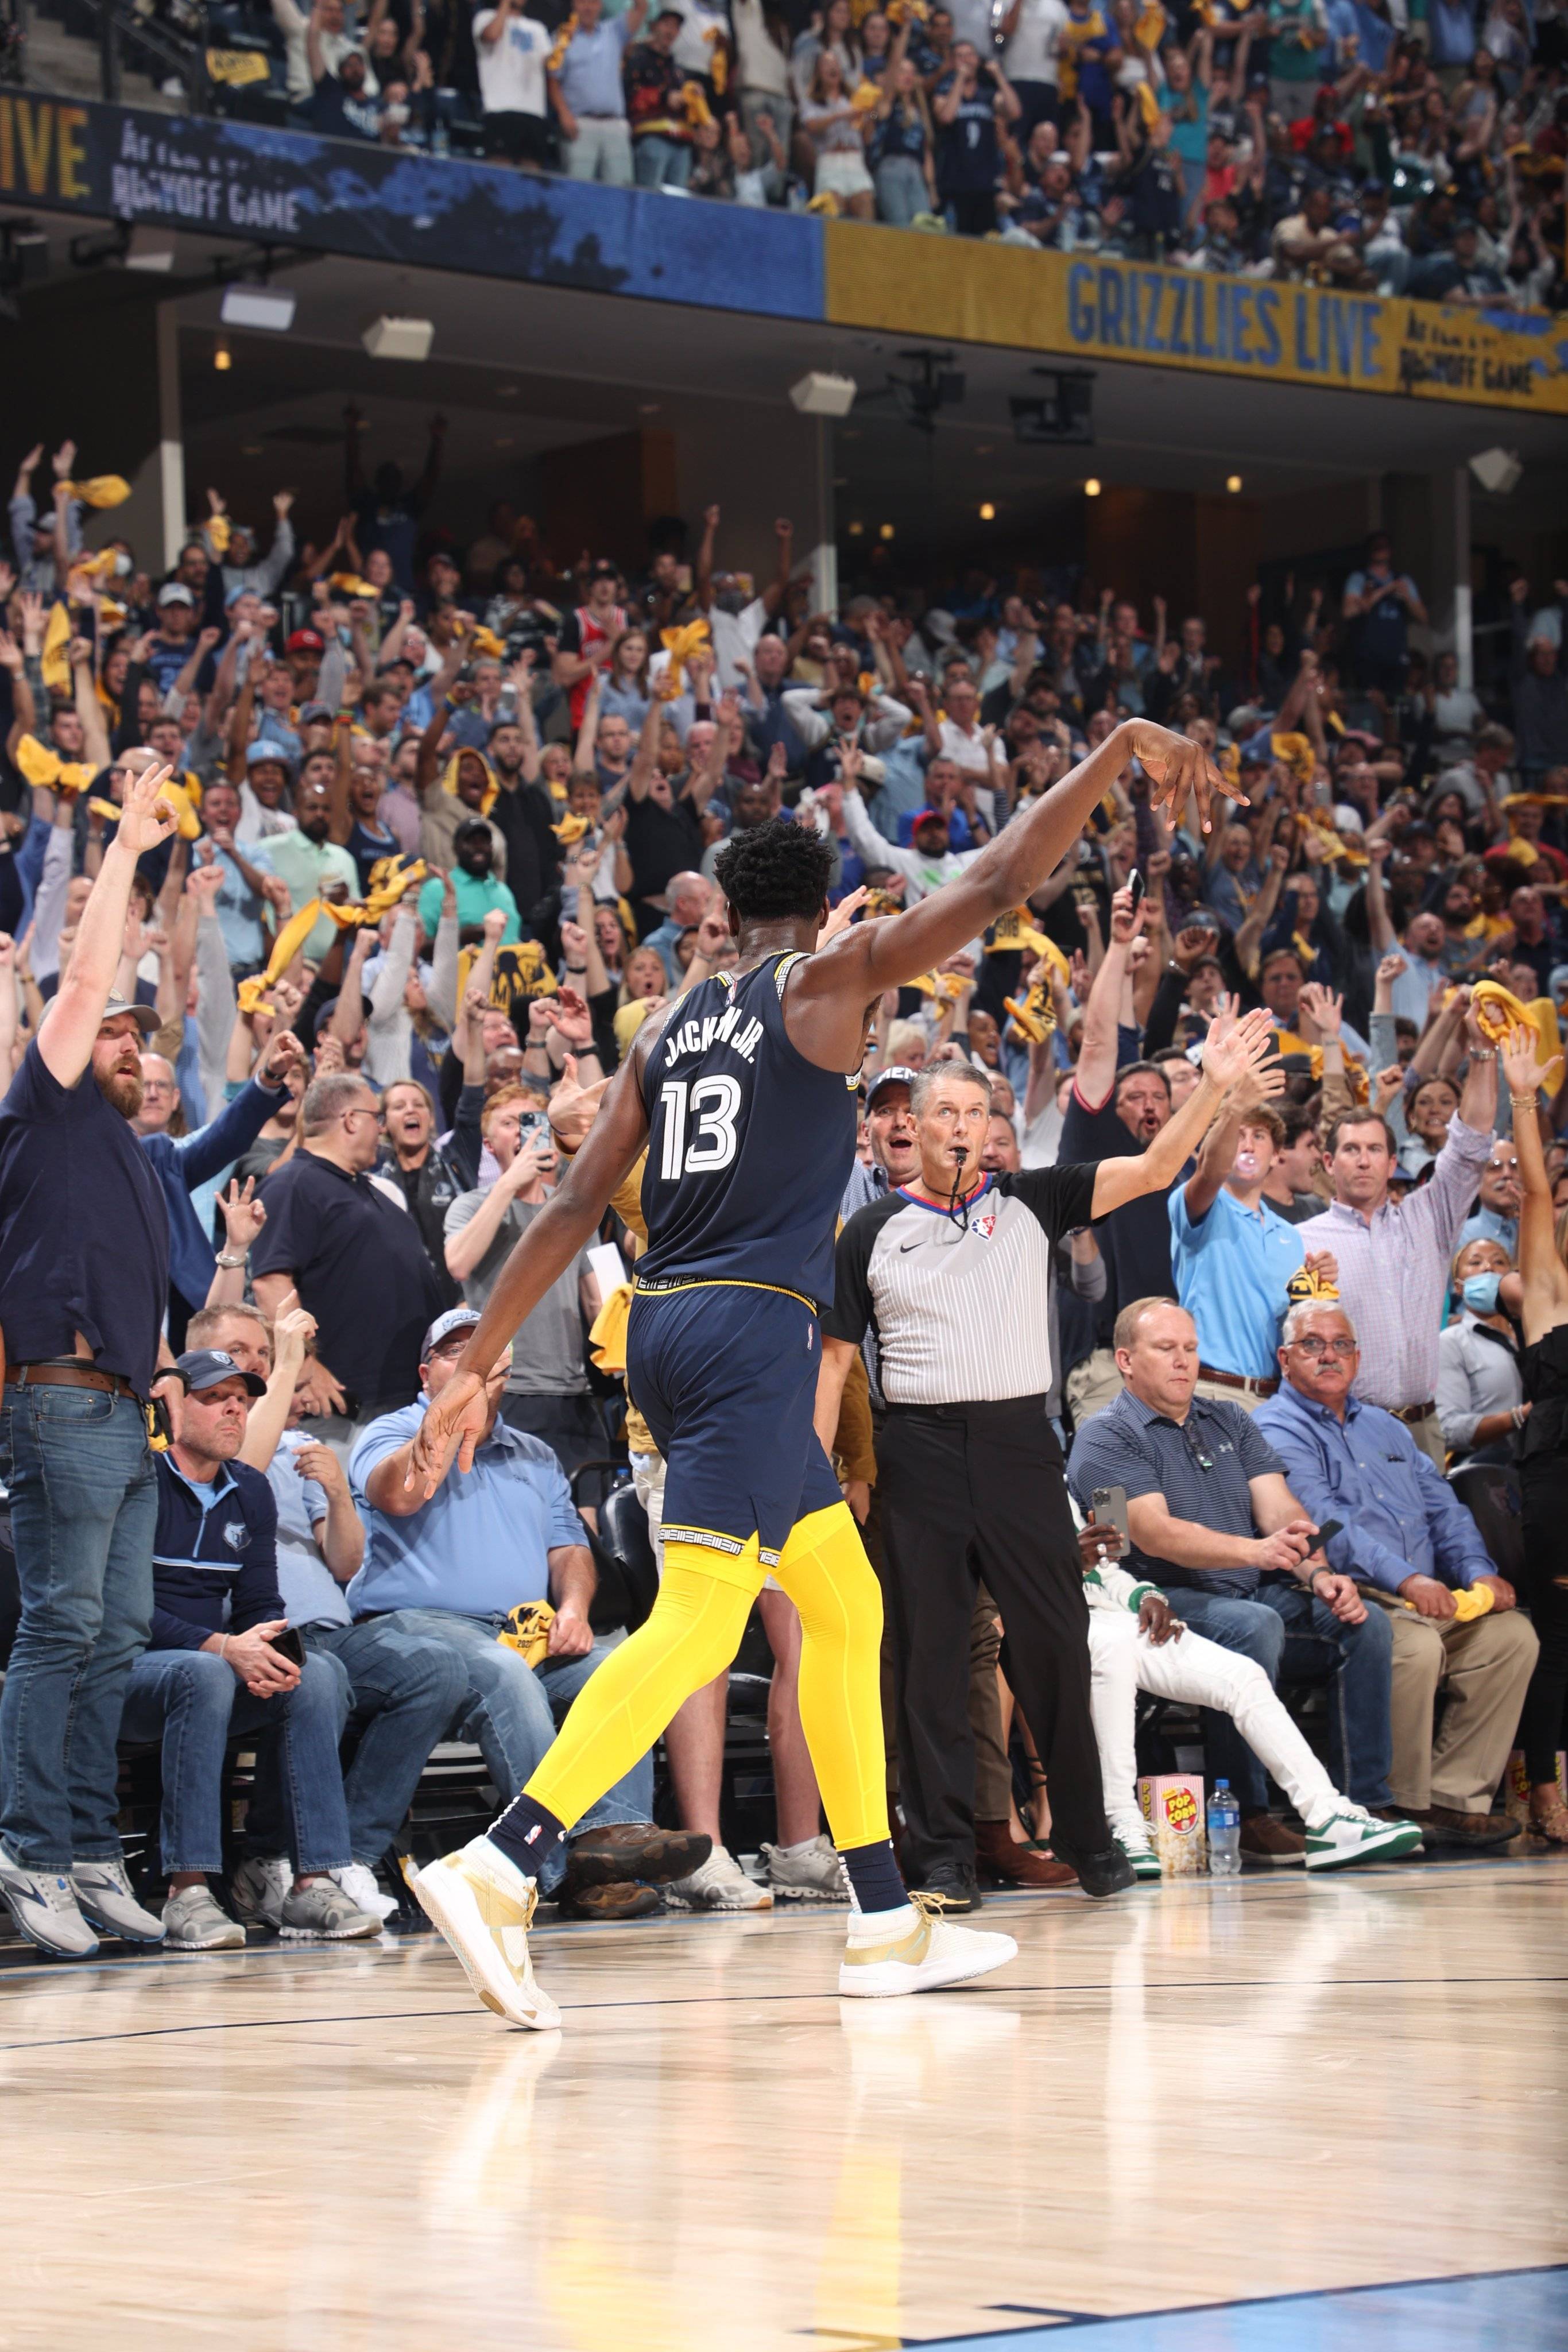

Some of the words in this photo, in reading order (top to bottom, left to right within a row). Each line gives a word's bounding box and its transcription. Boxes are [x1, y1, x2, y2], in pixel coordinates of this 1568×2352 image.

[1068, 262, 1281, 366] GRIZZLIES
[1295, 292, 1383, 377] LIVE
[664, 1005, 743, 1067] JACKN
[730, 1016, 764, 1064] JR.
[660, 1074, 741, 1180] 13
[1168, 1794, 1191, 1812] POP
[1168, 1803, 1197, 1825] CORN
